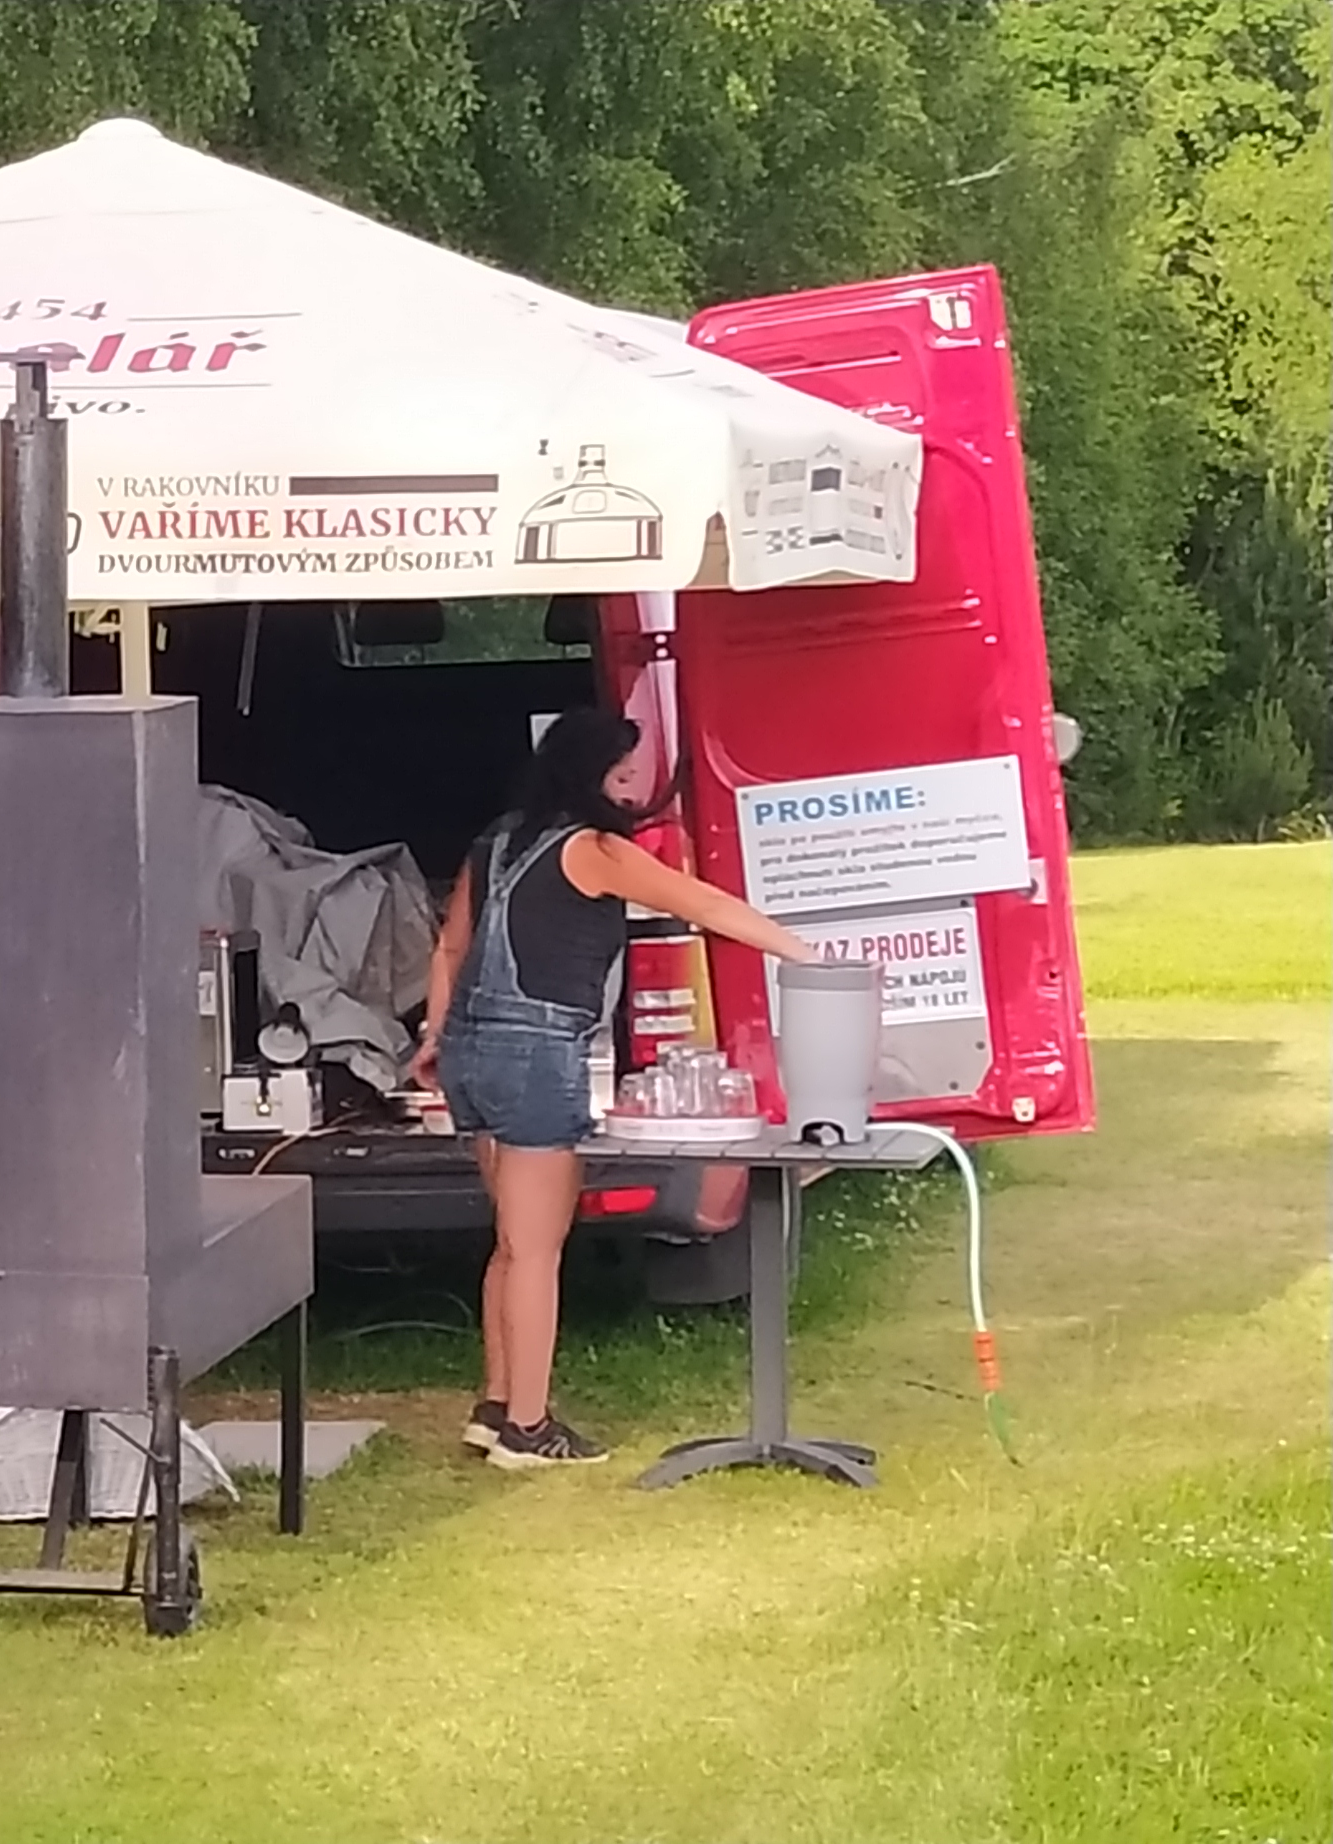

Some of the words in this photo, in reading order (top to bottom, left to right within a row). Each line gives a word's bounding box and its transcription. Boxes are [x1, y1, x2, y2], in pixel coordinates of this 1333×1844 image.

[5, 394, 146, 421] ivo.
[96, 476, 114, 498] V
[123, 470, 280, 498] RAKOVNÍKU
[97, 500, 271, 540] VAŘÍME
[281, 505, 498, 539] KLASICKY
[97, 546, 337, 574] DVOURMUTOVÝM
[344, 544, 495, 574] ZPŮSOBEM
[754, 785, 927, 827] PROSÍME:
[860, 926, 968, 962] PRODEJE
